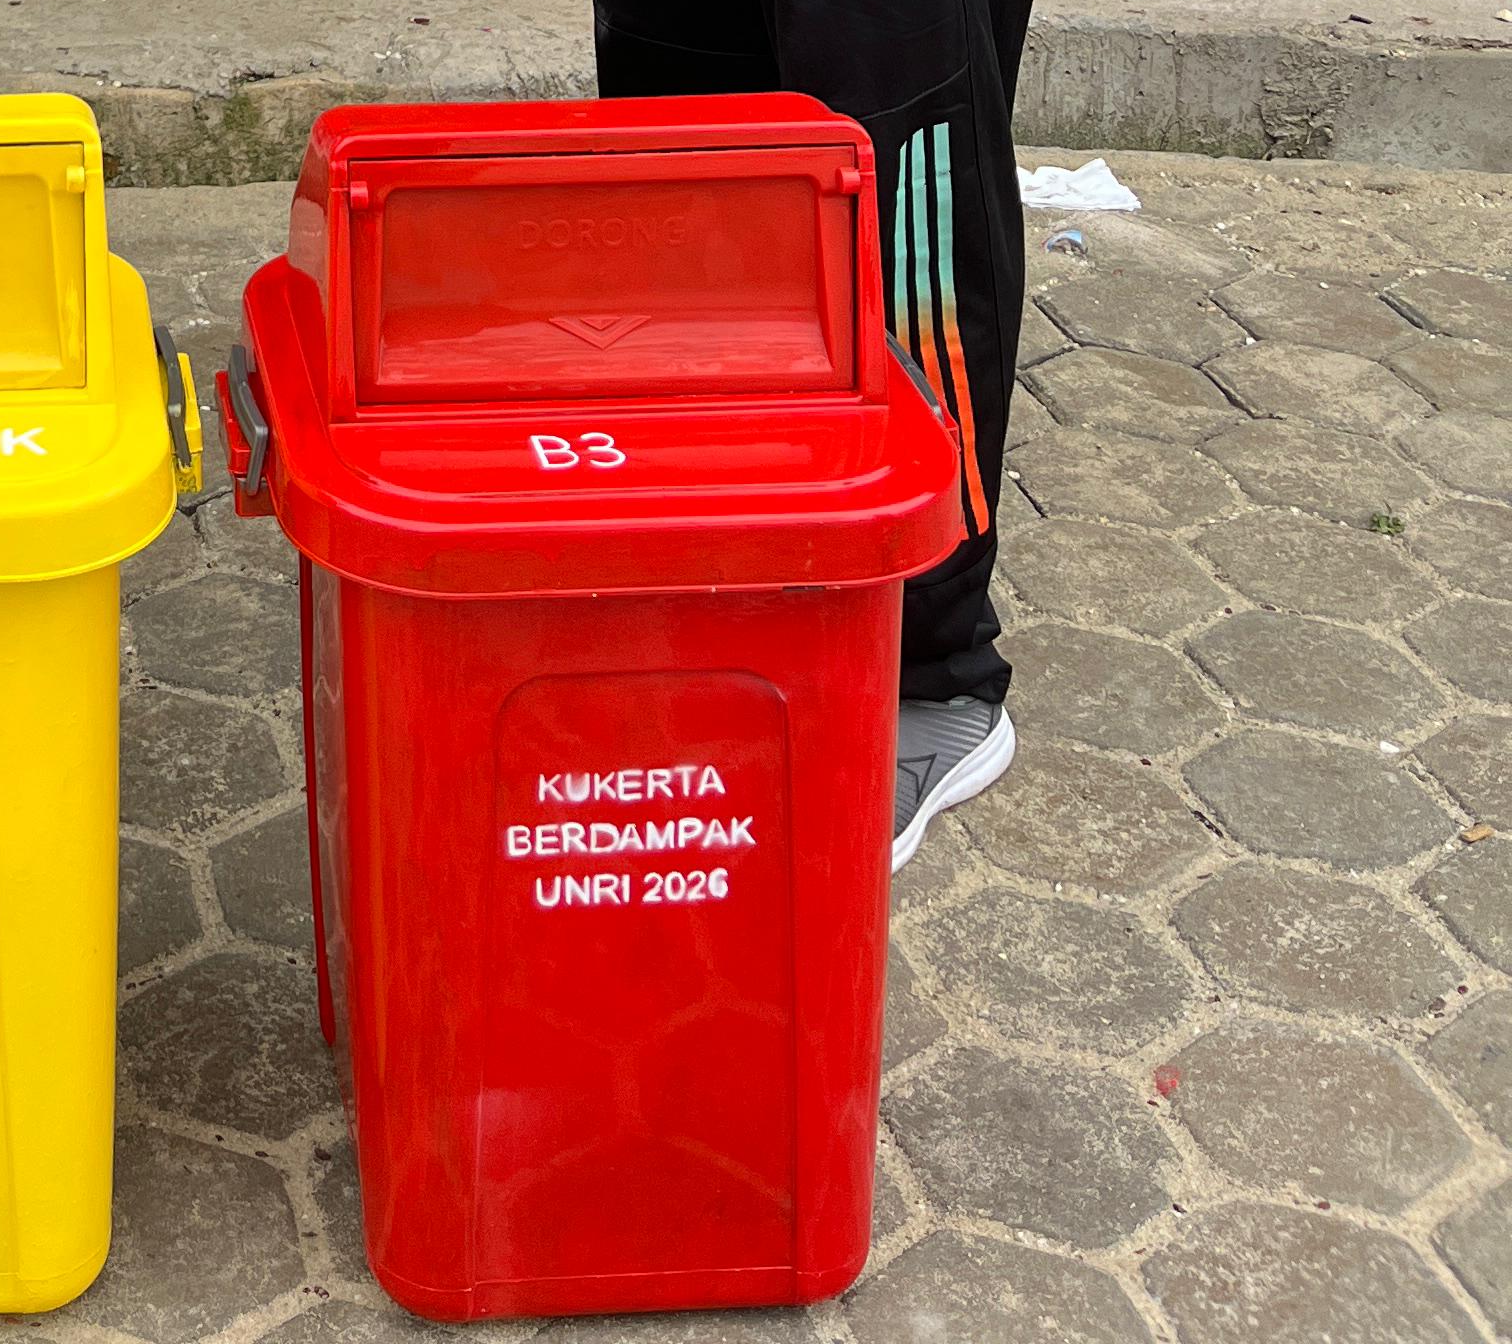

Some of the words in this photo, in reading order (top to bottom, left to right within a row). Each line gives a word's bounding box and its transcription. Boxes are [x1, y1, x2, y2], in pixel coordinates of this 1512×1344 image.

[528, 431, 627, 470] B3
[537, 764, 726, 803] KUKERTA
[505, 816, 756, 858] BERDAMPAK
[535, 872, 631, 908] UNRI
[641, 867, 729, 904] 2026
